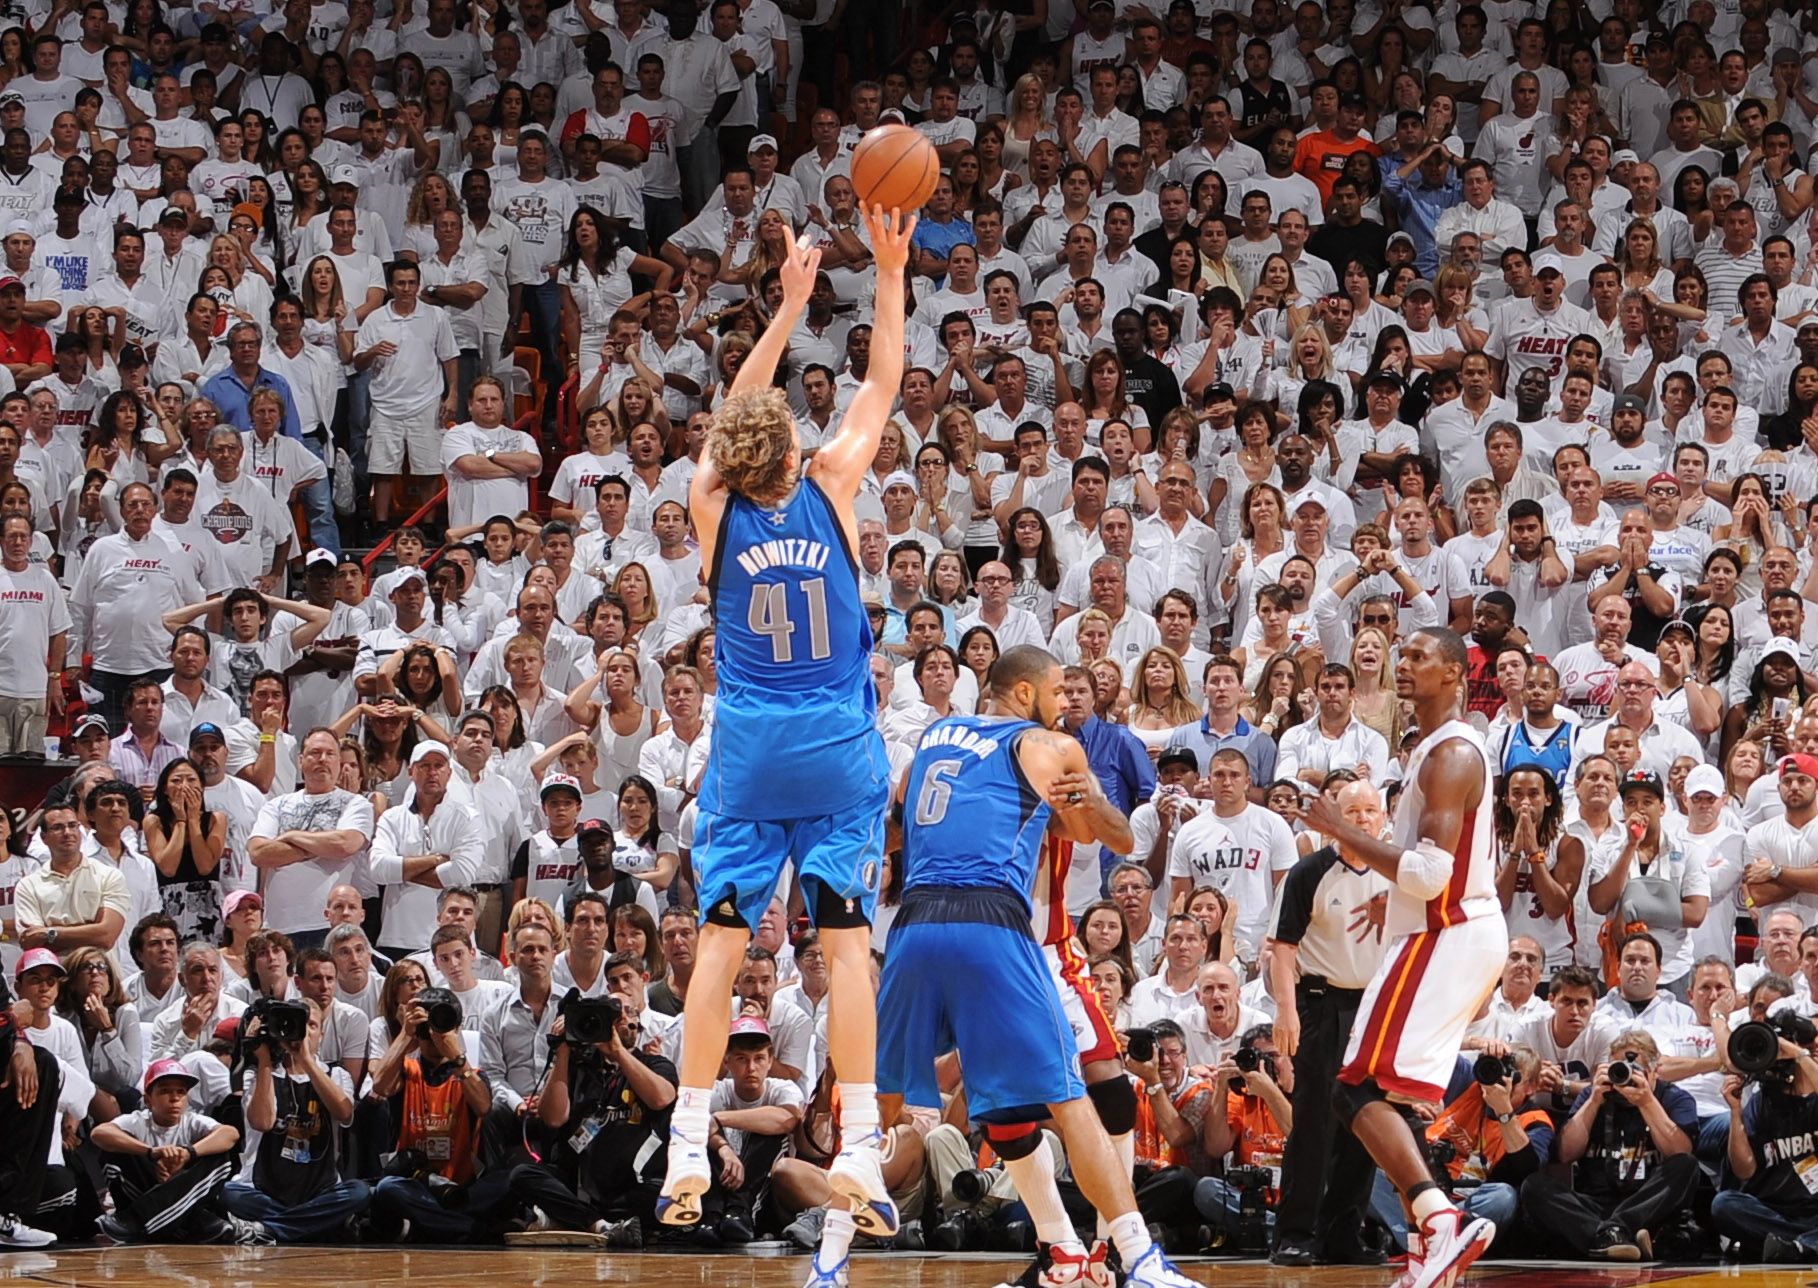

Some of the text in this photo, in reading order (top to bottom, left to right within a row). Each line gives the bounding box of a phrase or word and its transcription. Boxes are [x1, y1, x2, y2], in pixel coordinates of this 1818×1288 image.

[1748, 197, 1779, 214] HEA
[1517, 334, 1571, 356] HEAT
[1546, 357, 1564, 378] 3
[255, 467, 284, 478] AMI
[201, 513, 253, 532] CHAMPIONS
[124, 559, 161, 571] HEAT
[736, 538, 830, 577] NOWITZKI
[2, 591, 43, 603] MIAMI
[747, 577, 831, 663] 41
[915, 759, 963, 826] 6
[535, 864, 581, 882] HEAT
[1528, 896, 1545, 919] 3
[1776, 1134, 1813, 1160] NBA
